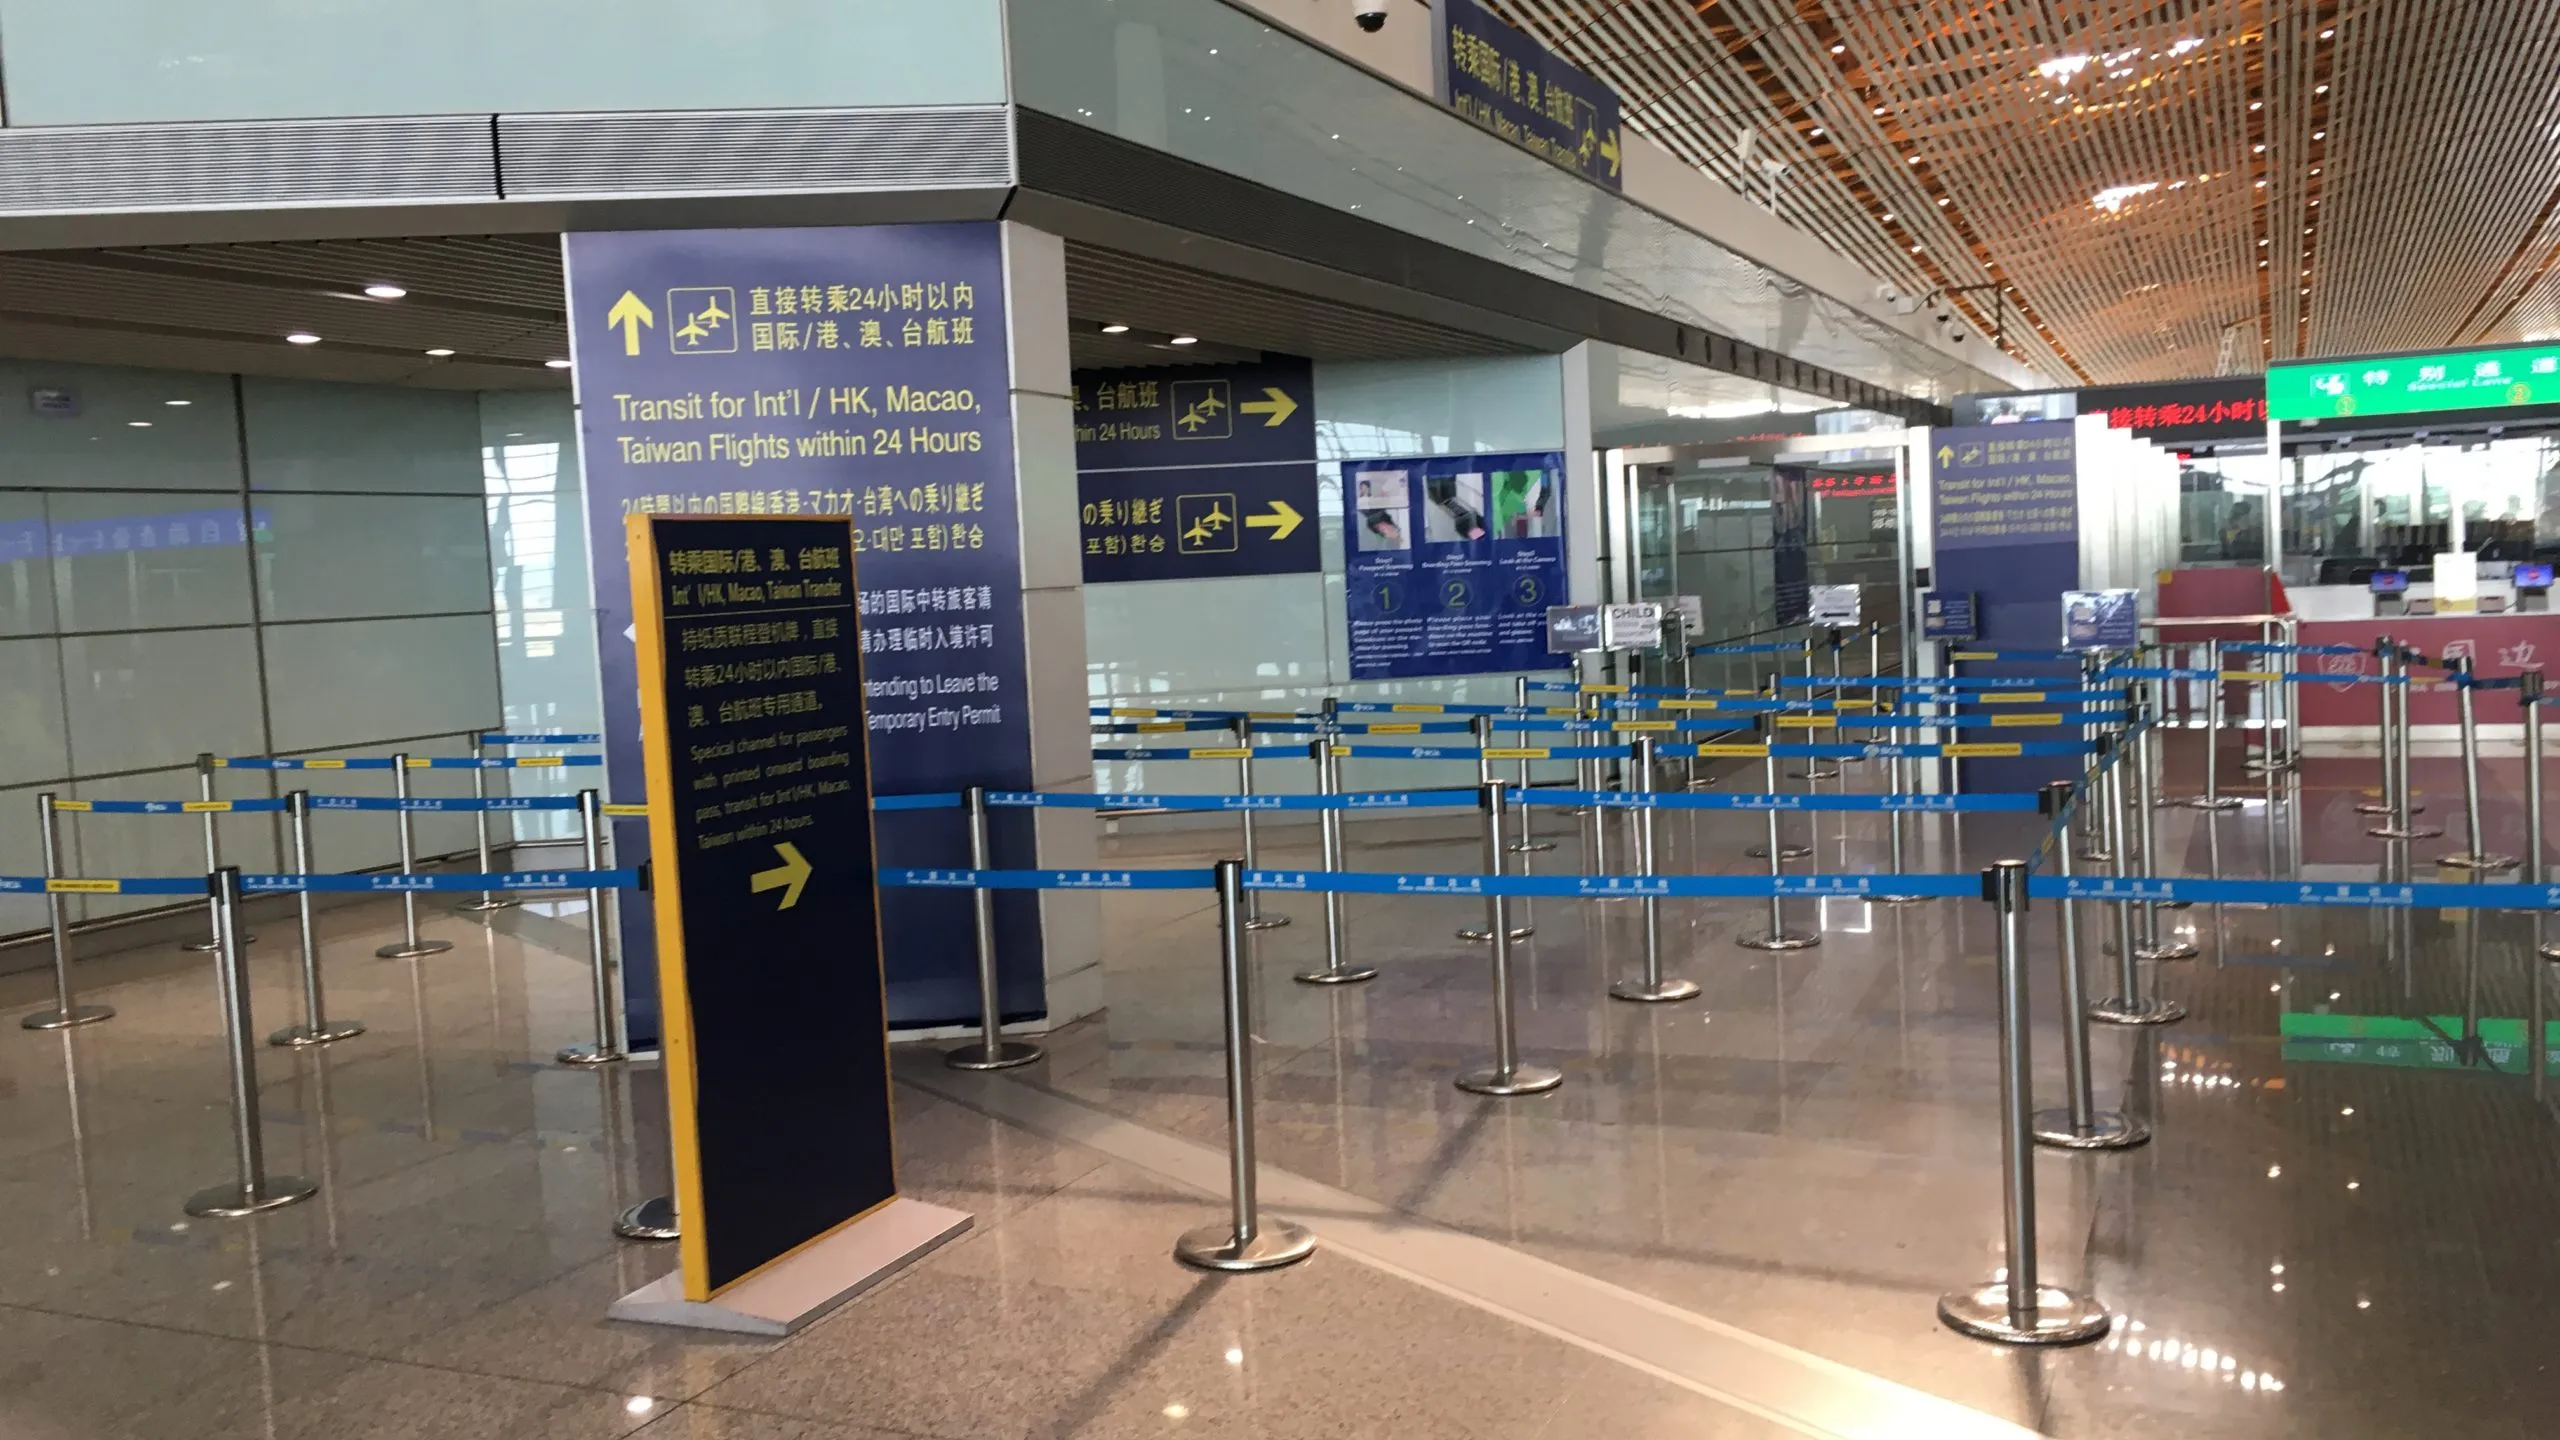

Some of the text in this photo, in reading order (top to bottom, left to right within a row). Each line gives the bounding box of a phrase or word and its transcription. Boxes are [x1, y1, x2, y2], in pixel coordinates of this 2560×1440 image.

[749, 282, 974, 315] 直接转乘24小时以内
[751, 316, 975, 351] 国际/港、澳、台航班
[613, 385, 981, 422] Transit for Int'l / HK, Macao,
[1099, 423, 1117, 441] 24
[1120, 421, 1161, 440] Hours
[617, 427, 981, 468] Taiwan Flights within 24 Hours
[910, 524, 948, 552] 포함)
[951, 523, 985, 550] 환승
[1130, 533, 1166, 553] 환승
[669, 546, 841, 575] 转乘国际/港、澳、台航班
[766, 579, 801, 600] Taiwan
[802, 577, 842, 598] Transfer
[1378, 586, 1390, 610] 1
[1448, 583, 1465, 608] 2
[1519, 578, 1537, 603] 3
[1612, 607, 1655, 619] CHILD
[920, 675, 933, 695] to
[936, 674, 976, 694] Leave
[977, 672, 999, 691] the
[928, 707, 960, 731] Entry
[962, 704, 1002, 725] Permit
[778, 731, 794, 746] for
[769, 818, 783, 834] 24
